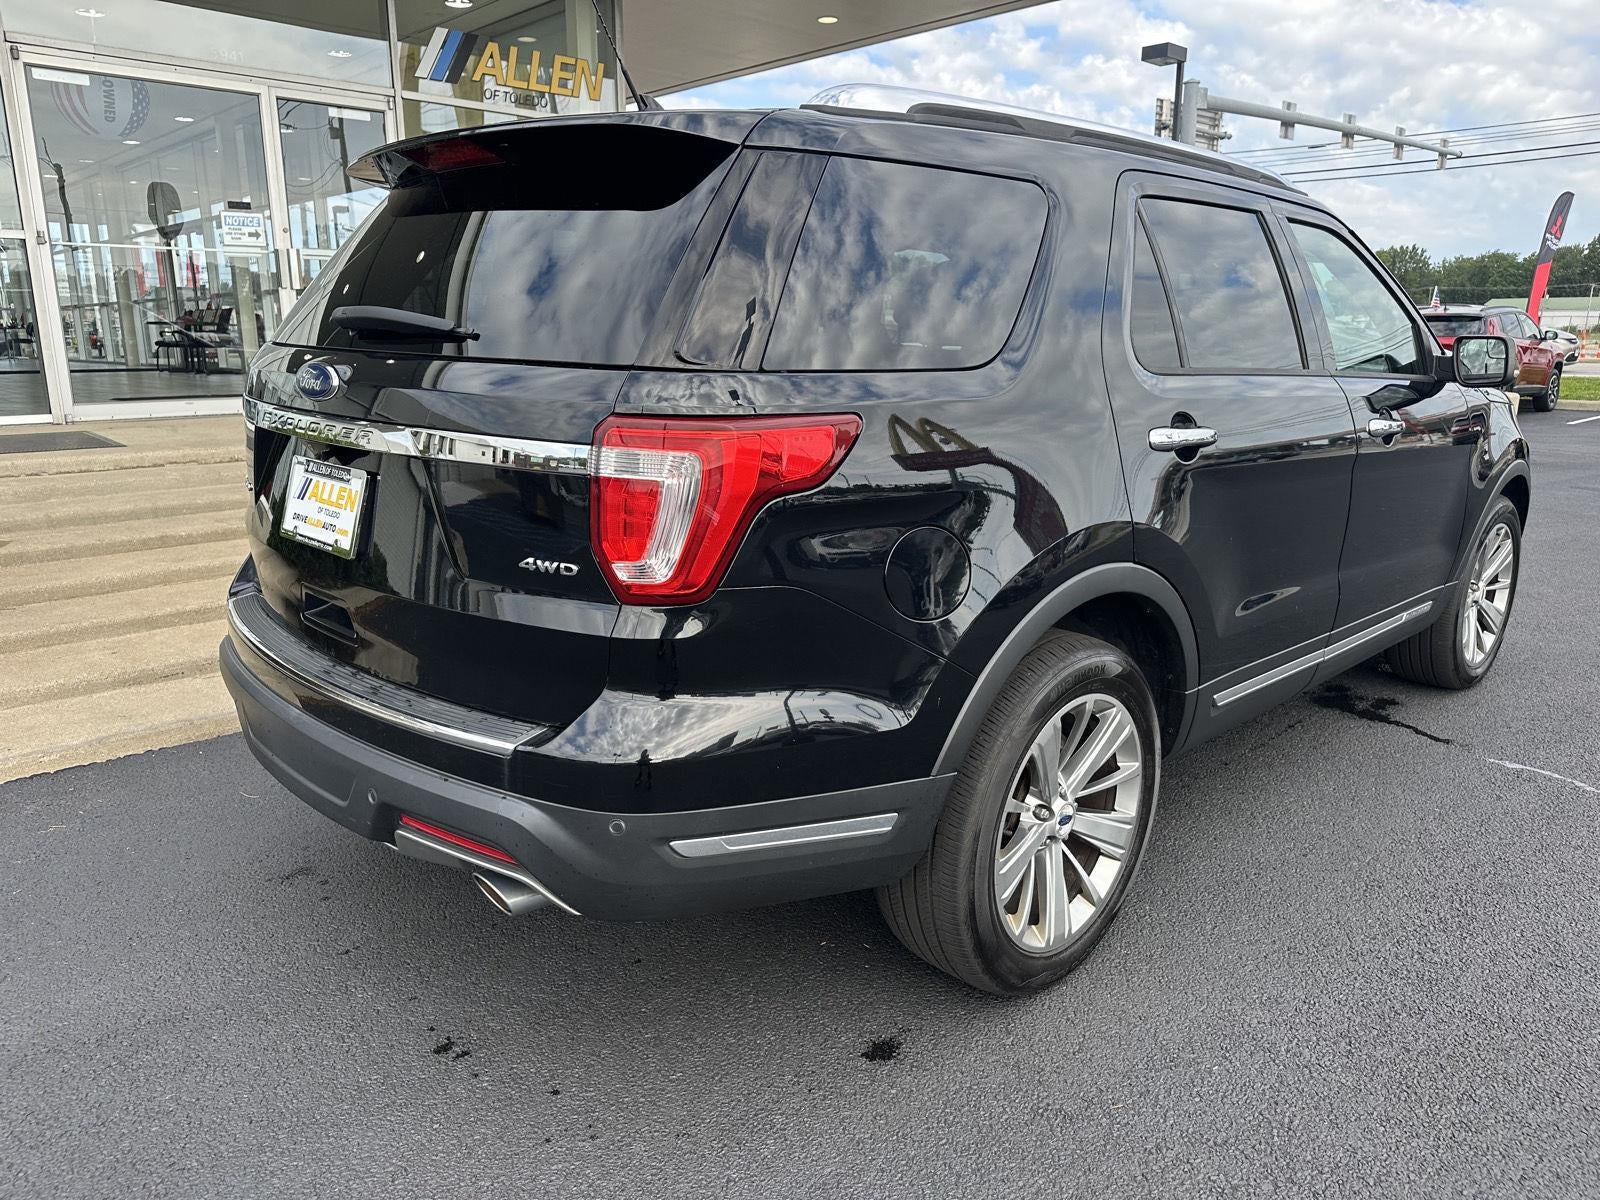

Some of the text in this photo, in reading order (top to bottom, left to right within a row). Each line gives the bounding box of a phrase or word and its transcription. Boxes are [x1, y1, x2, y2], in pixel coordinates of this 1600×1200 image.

[471, 41, 605, 101] ALLEN
[483, 87, 548, 108] OF TOLEDO
[225, 215, 260, 227] NOTICE
[300, 367, 324, 391] Ford
[261, 409, 375, 445] EXPLORER
[308, 479, 359, 513] ALLEN
[317, 506, 341, 519] OF TOLEDO
[518, 556, 580, 576] 4WD
